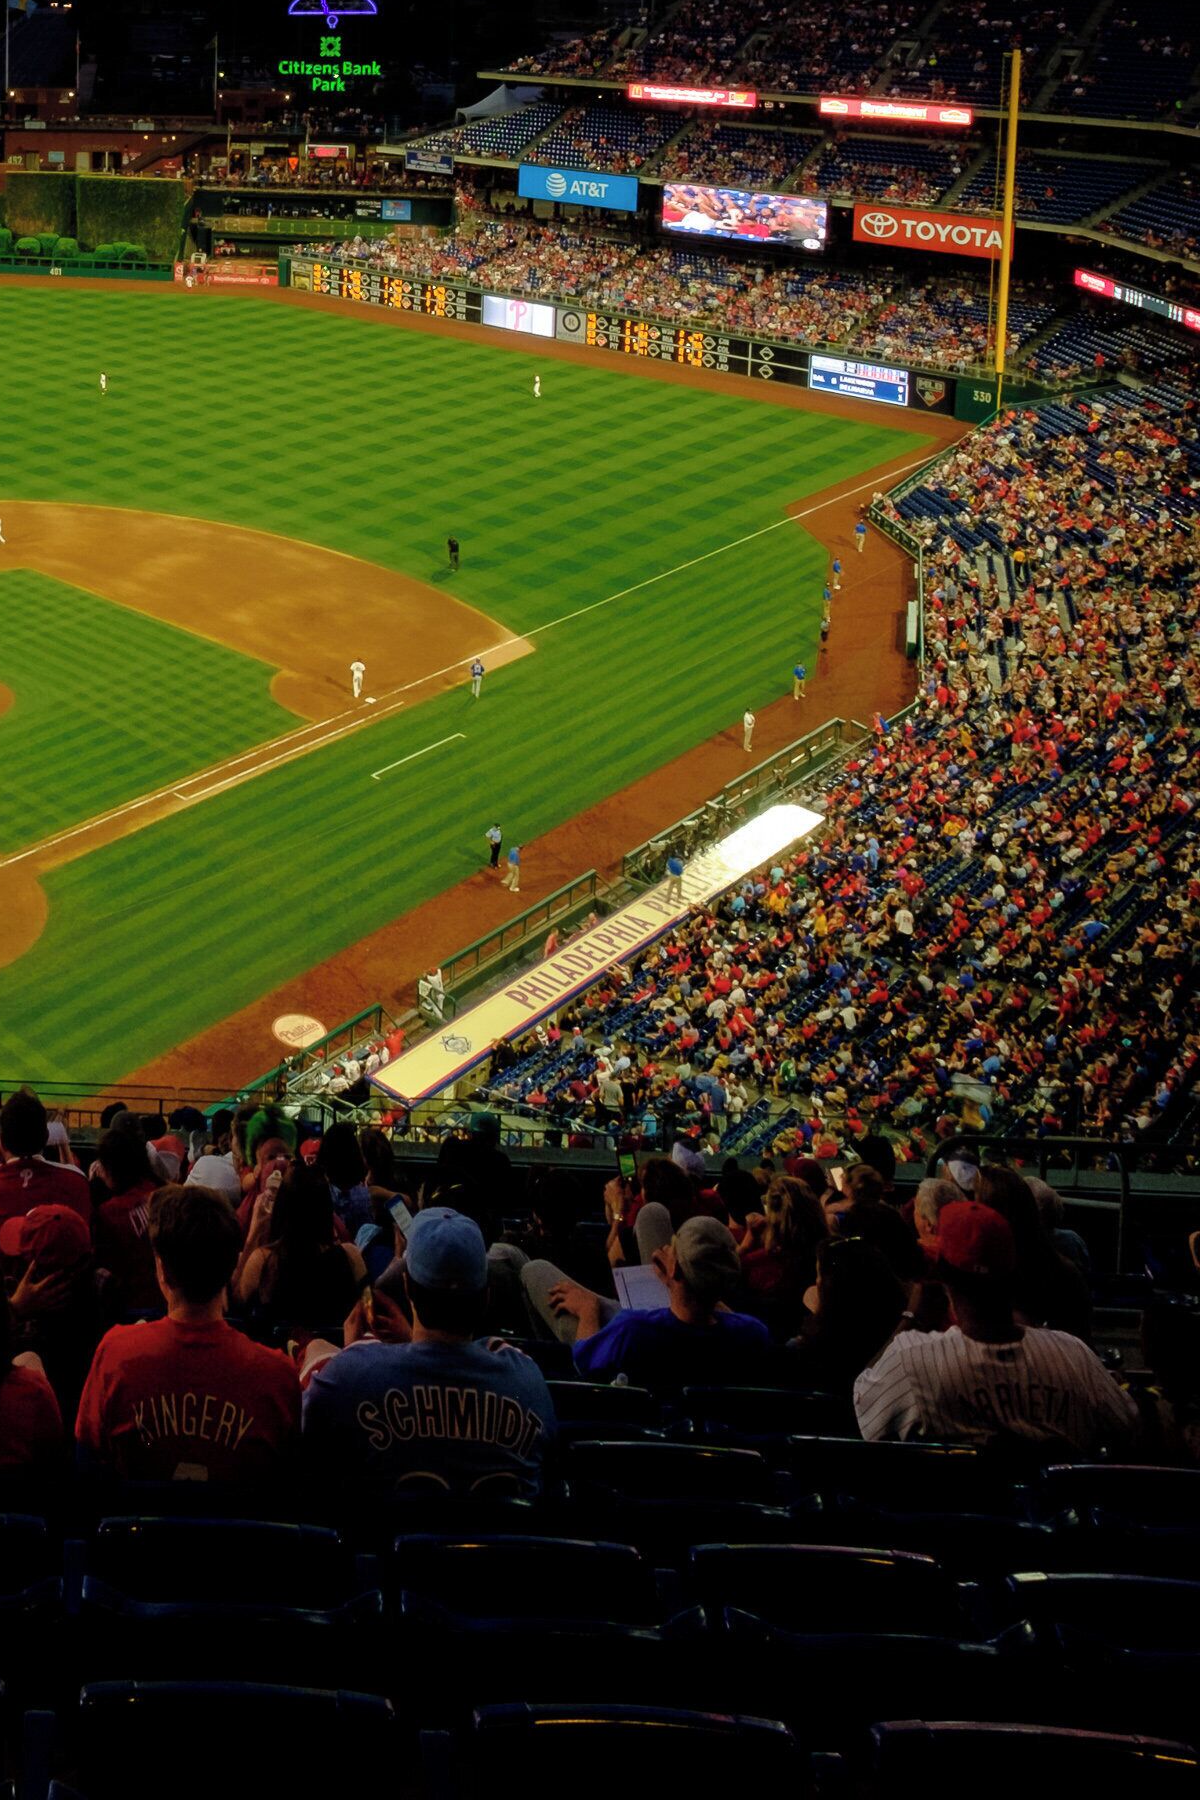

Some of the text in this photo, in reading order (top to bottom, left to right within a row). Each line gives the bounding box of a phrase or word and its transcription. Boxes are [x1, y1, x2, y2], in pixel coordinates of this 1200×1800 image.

[279, 61, 381, 75] Citizens Bank
[312, 77, 346, 92] Park
[570, 180, 609, 198] AT&T
[901, 219, 1003, 249] TOYOTA
[50, 267, 62, 276] 401
[973, 390, 991, 403] 330
[504, 914, 653, 1009] PHILADELPHIA
[132, 1392, 254, 1452] KINGERY
[356, 1384, 545, 1461] SCHMIDT
